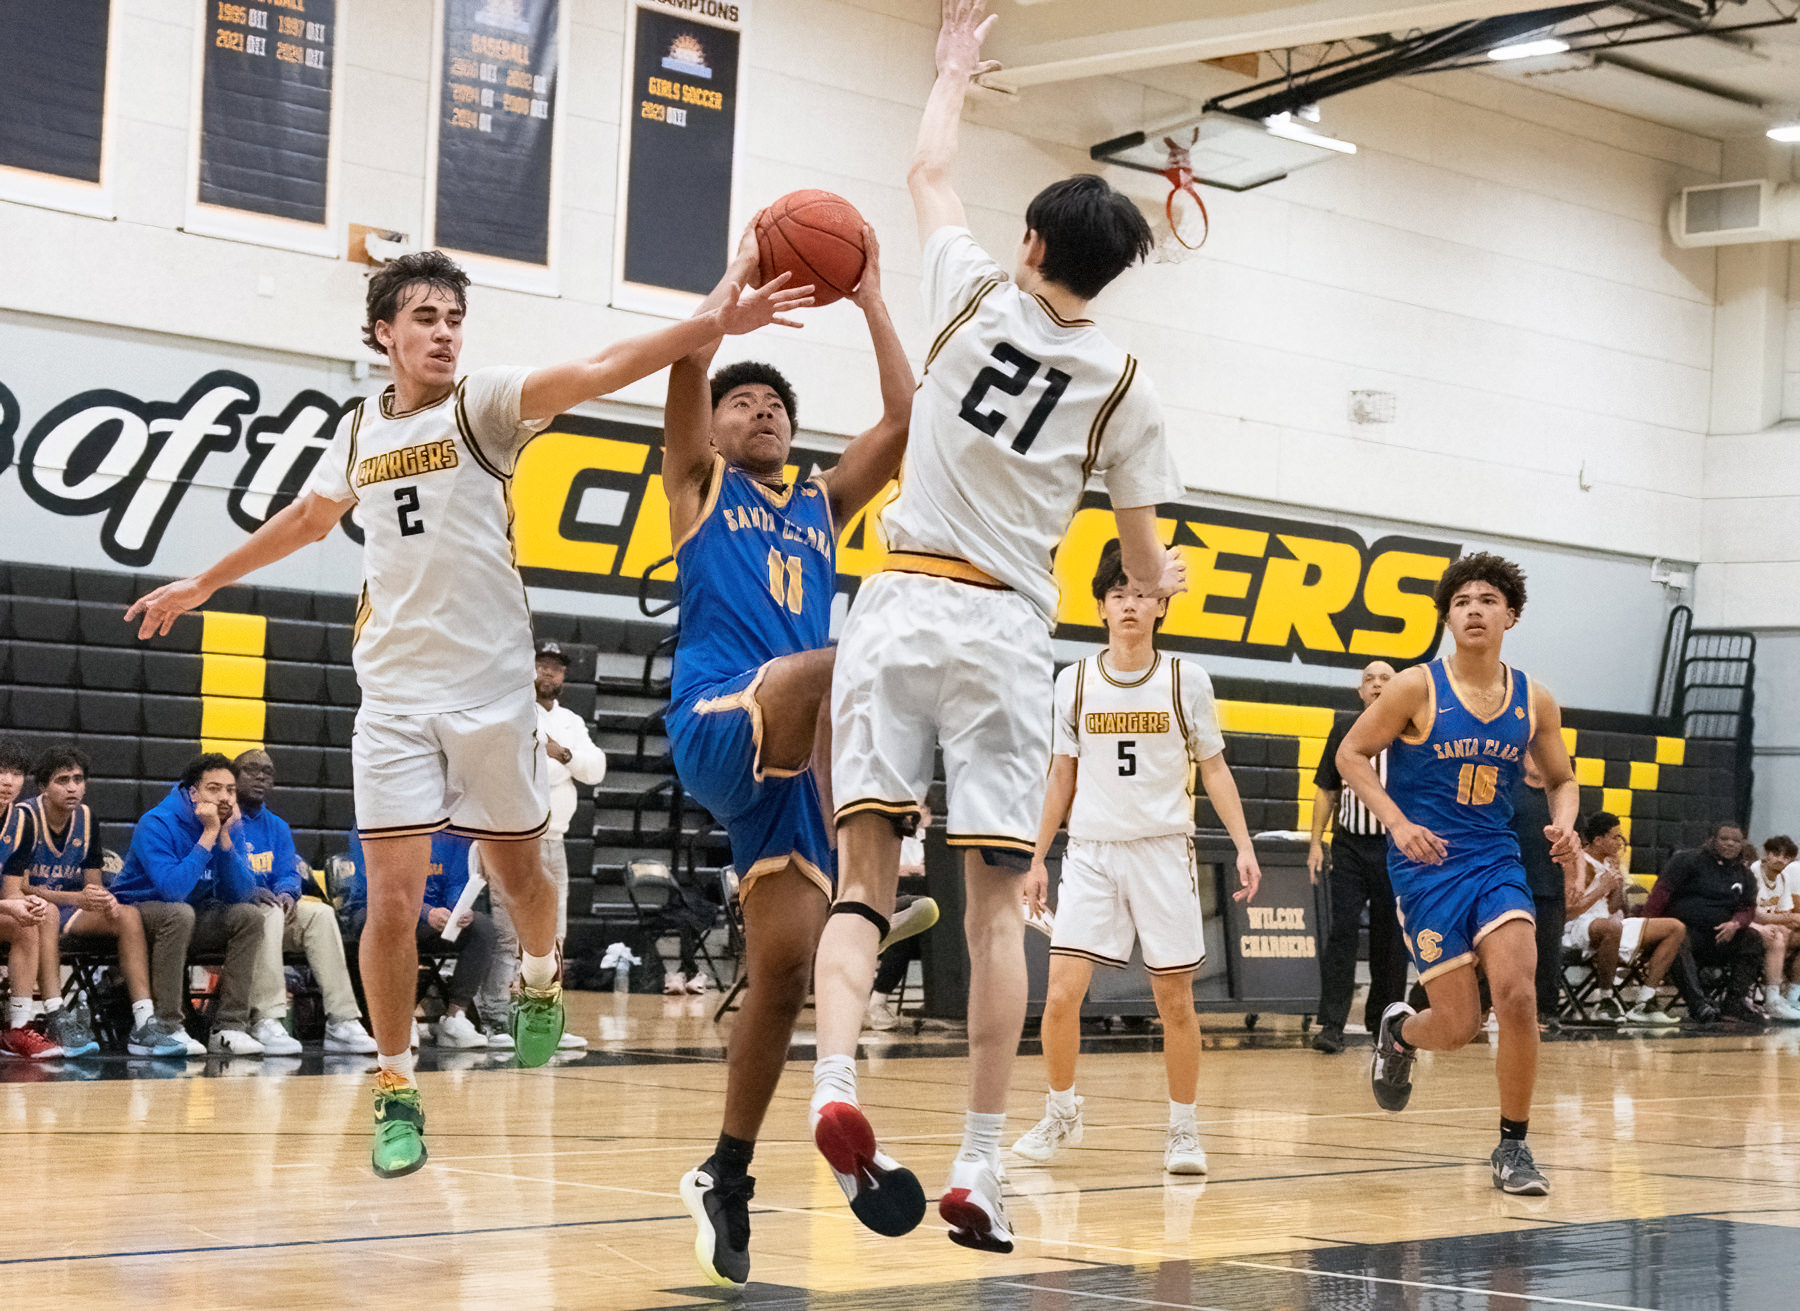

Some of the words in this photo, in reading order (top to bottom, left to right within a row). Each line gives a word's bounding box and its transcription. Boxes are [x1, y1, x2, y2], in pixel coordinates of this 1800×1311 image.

[648, 76, 681, 101] GIRLS
[681, 84, 723, 111] SOCCER
[958, 341, 1073, 456] 21
[24, 375, 256, 562] of
[356, 439, 459, 488] CHARGERS
[394, 485, 425, 537] 2
[767, 544, 803, 615] 11
[1085, 711, 1170, 734] CHARGERS
[1117, 740, 1136, 776] 5
[1432, 738, 1479, 759] SANTA
[1456, 763, 1499, 806] 16
[1246, 907, 1306, 930] WILCOX
[1240, 935, 1317, 958] CHARGERS
